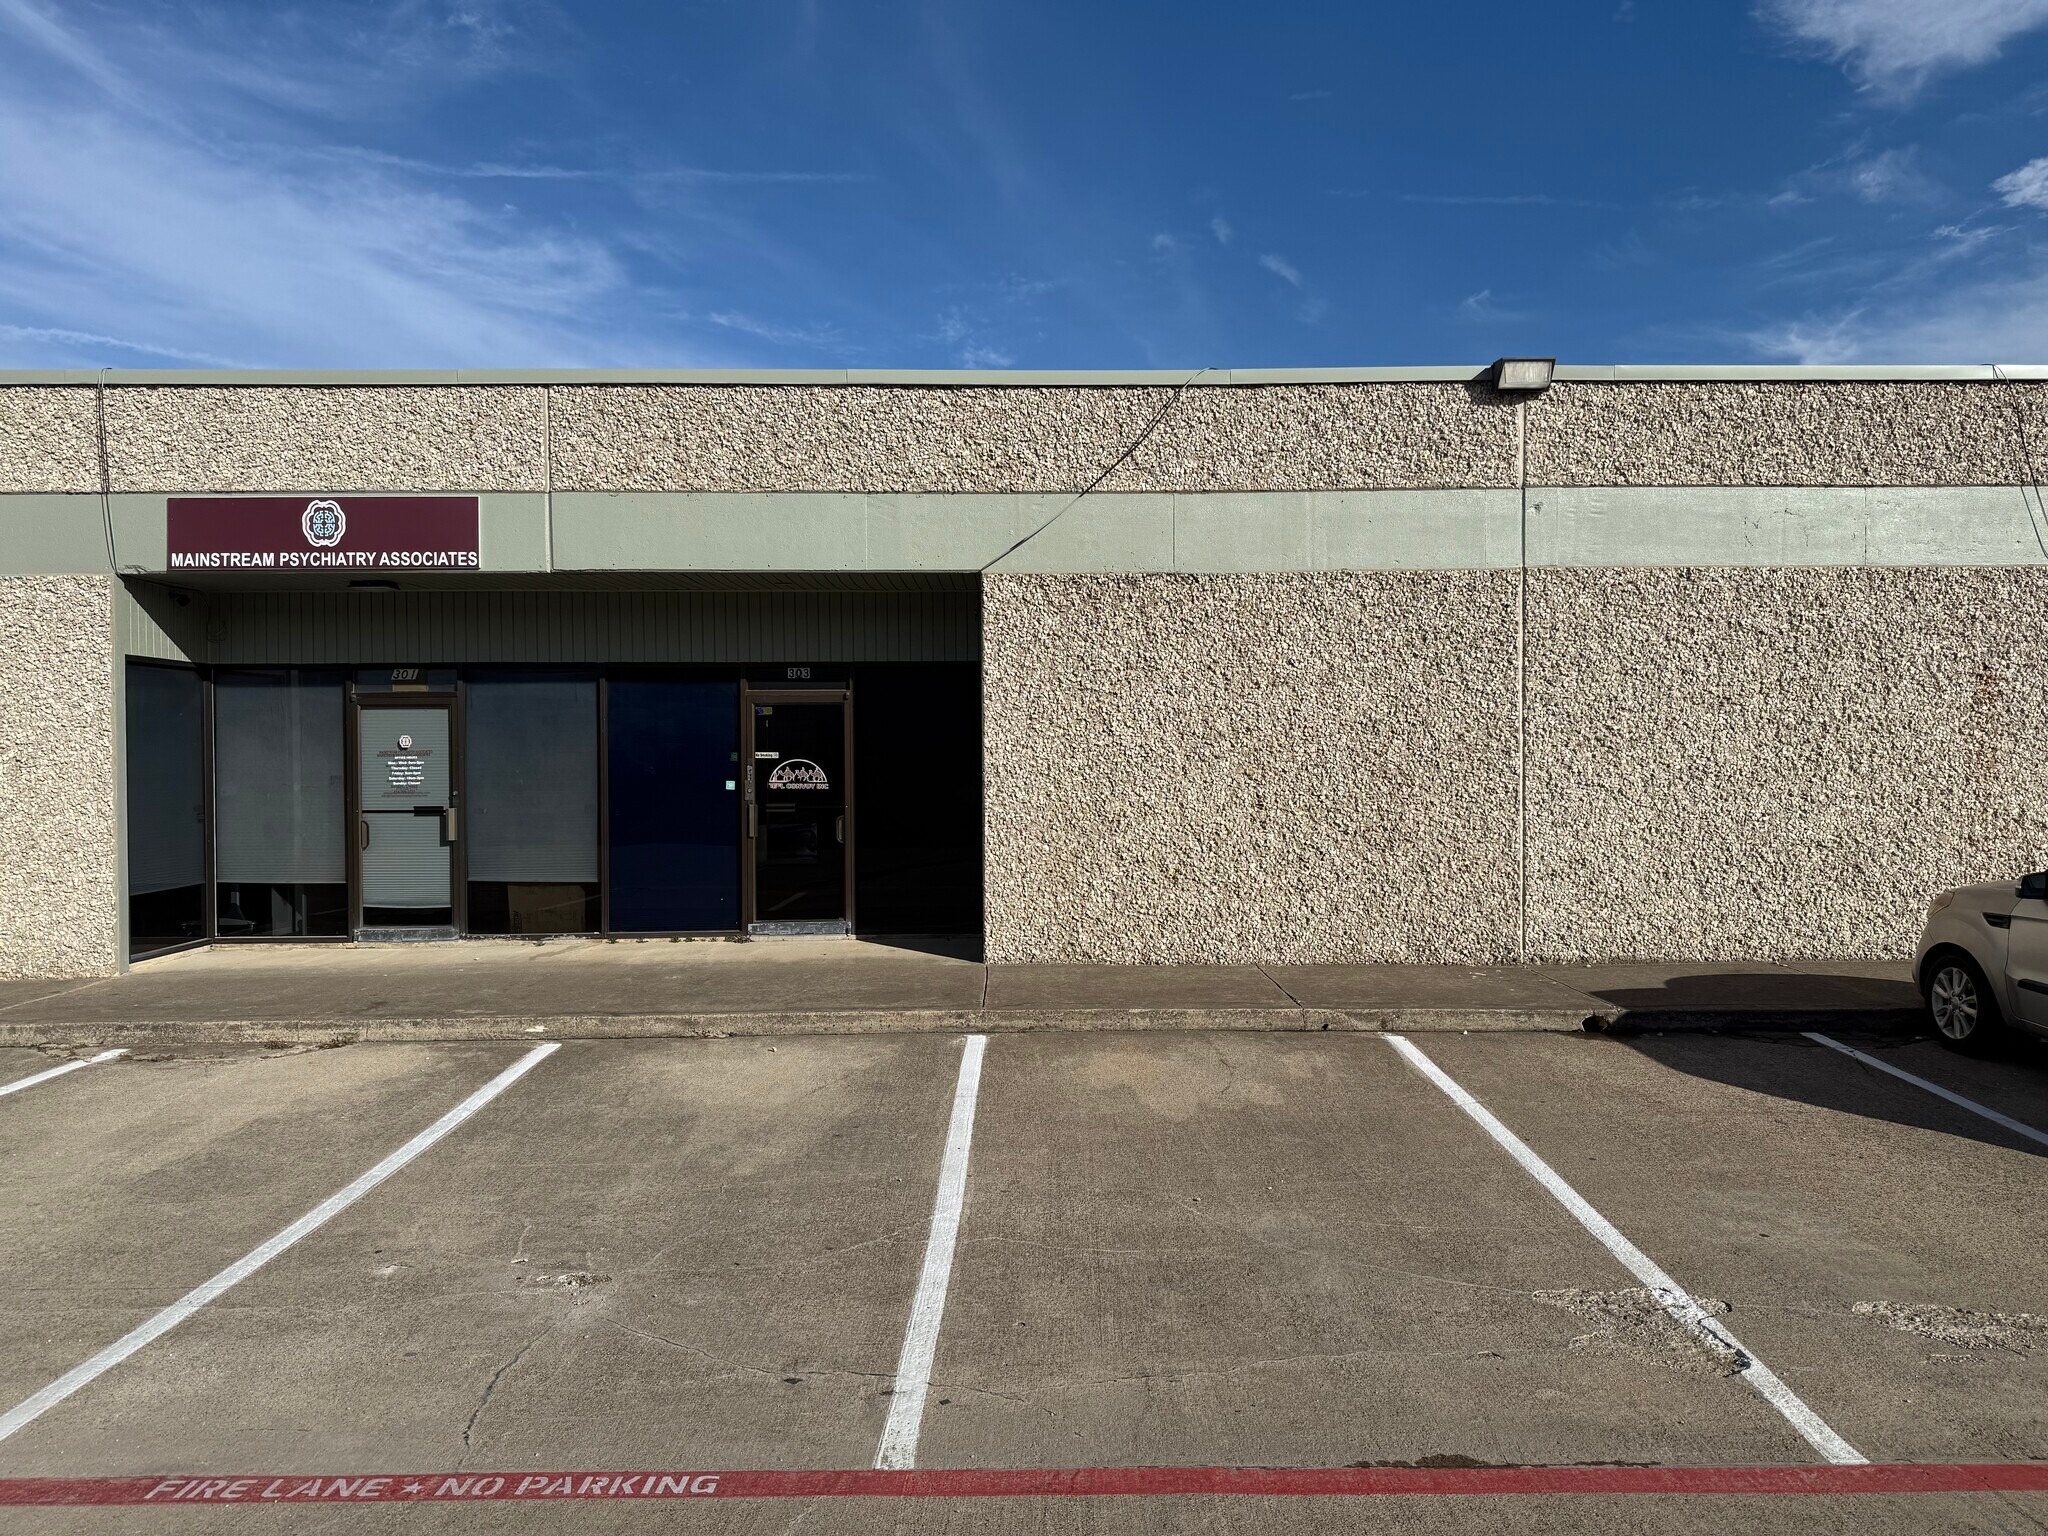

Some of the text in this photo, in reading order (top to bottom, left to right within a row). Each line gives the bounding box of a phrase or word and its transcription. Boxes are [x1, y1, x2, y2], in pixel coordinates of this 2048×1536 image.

[171, 551, 478, 567] MAINSTREAM PSYCHIATRY ASSOCIATES
[392, 669, 417, 680] 301
[787, 668, 810, 678] 303
[143, 1475, 720, 1499] FIRE LANE NO PARKING
